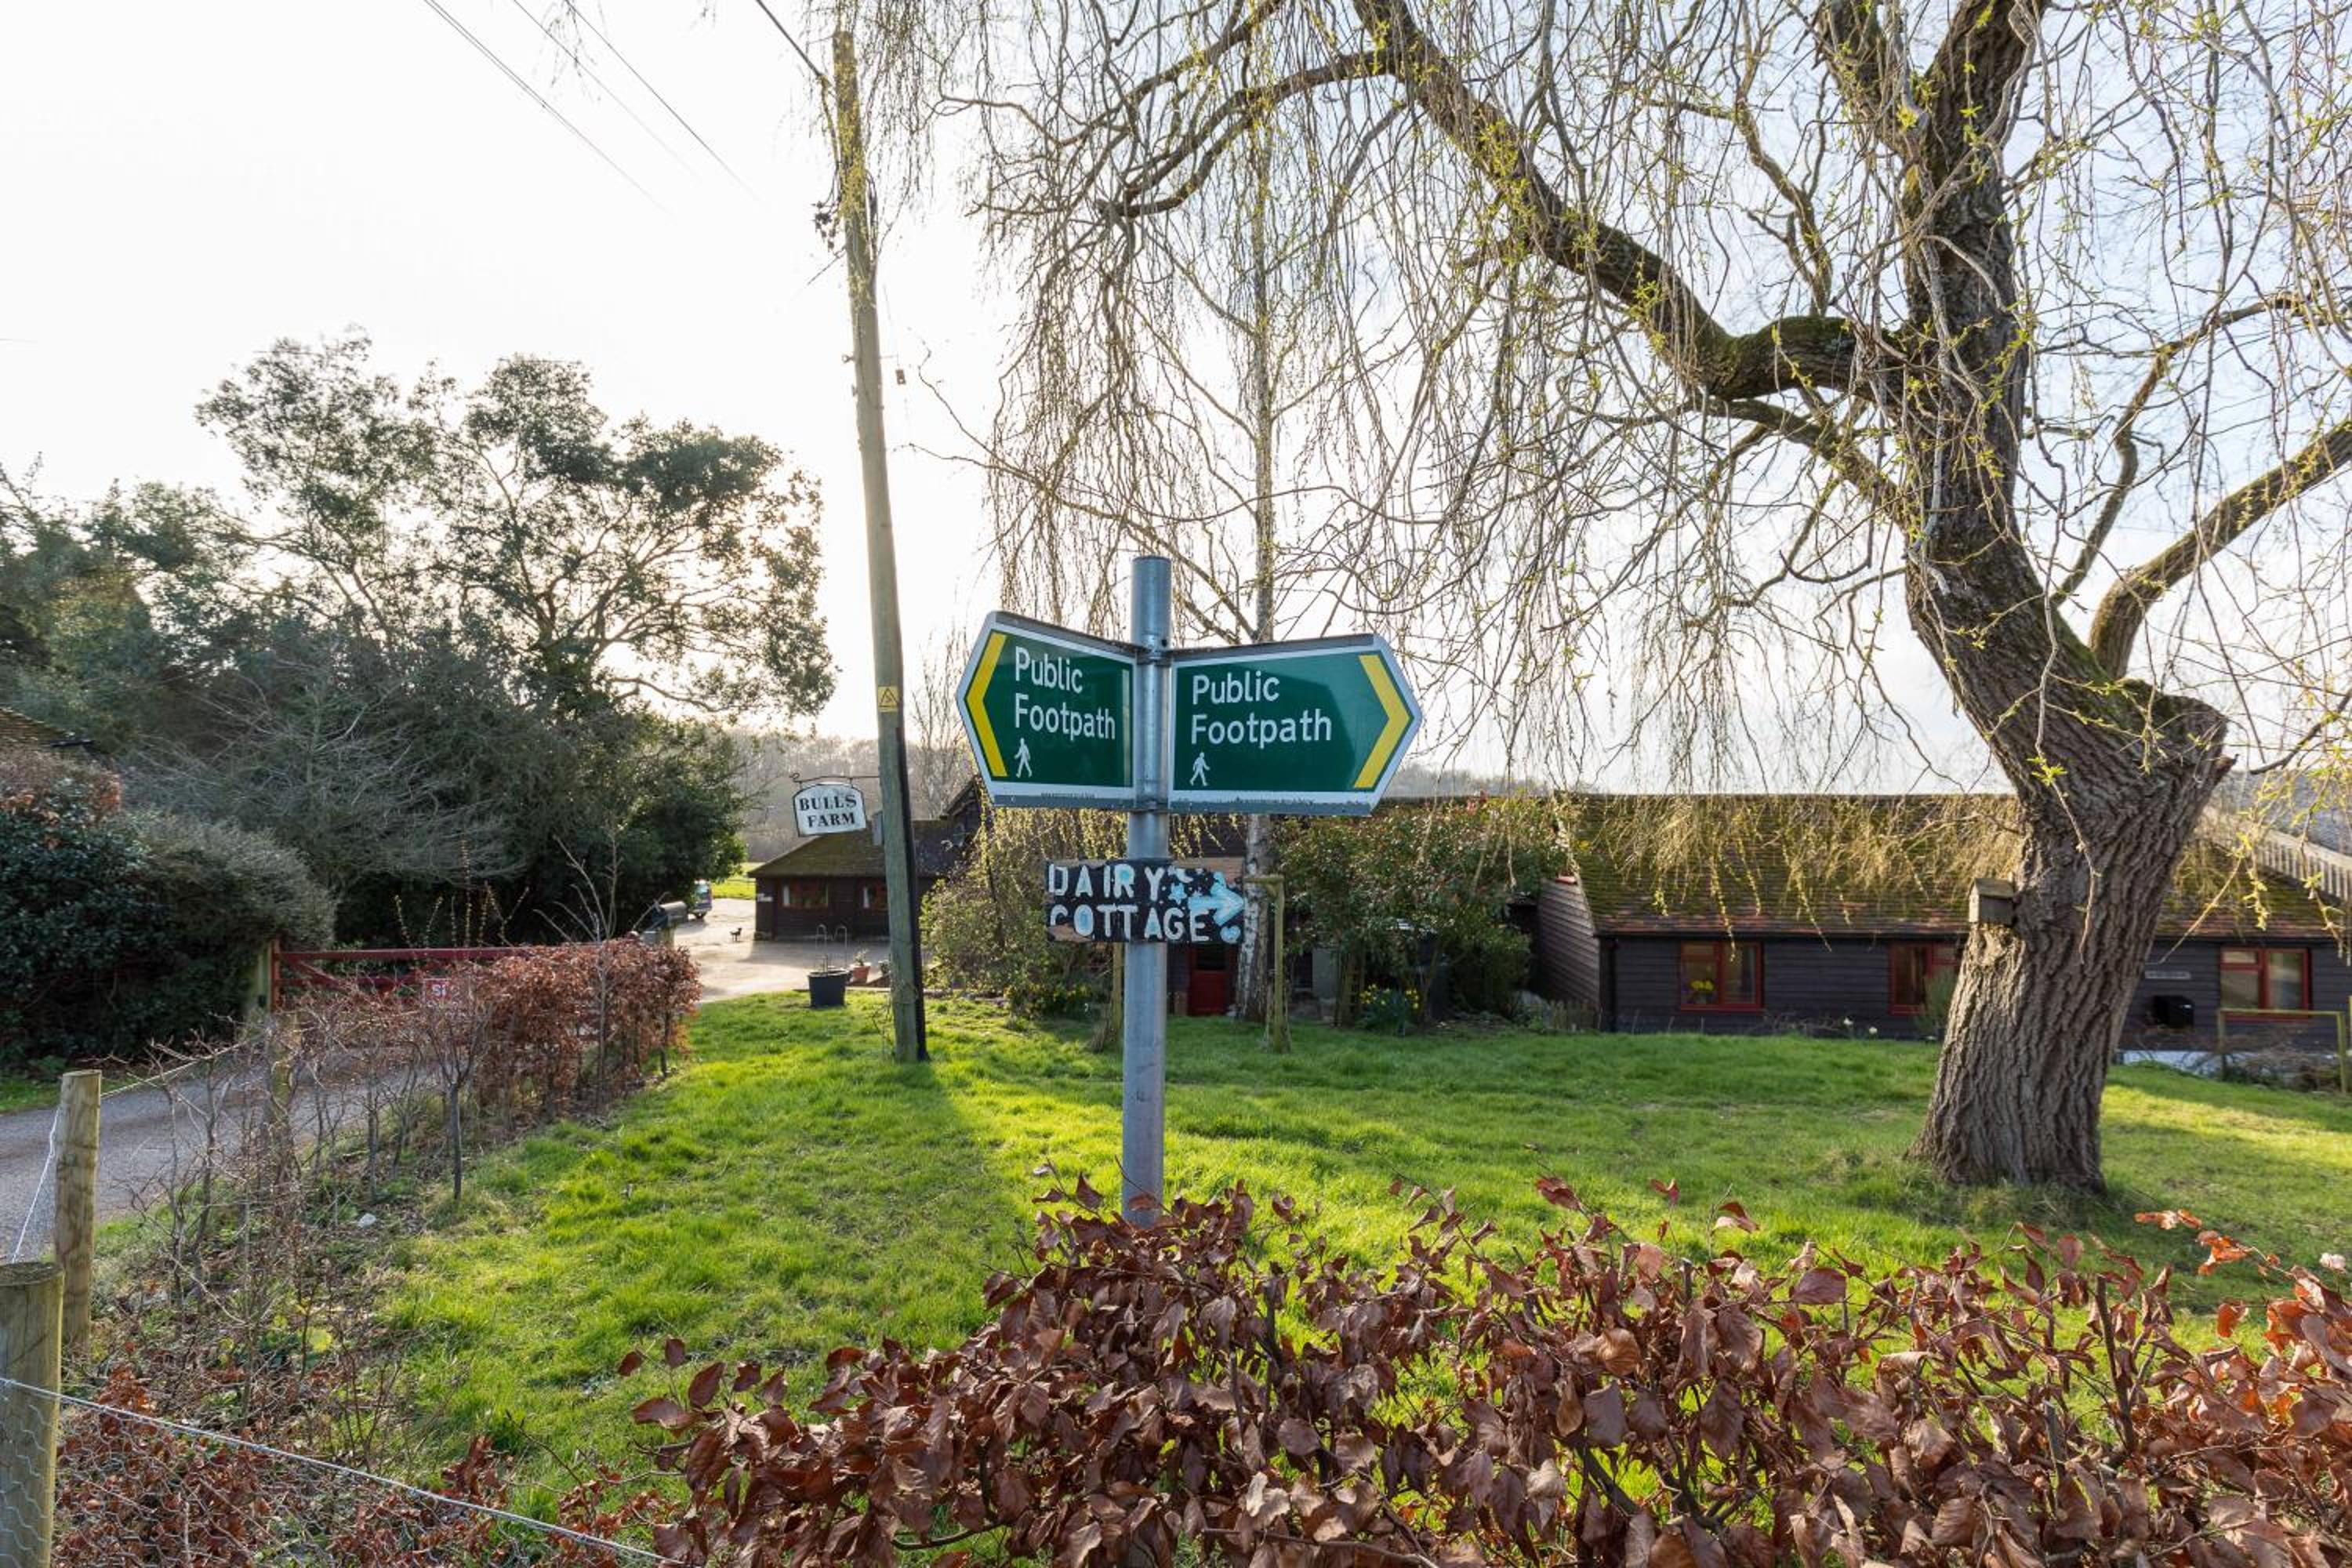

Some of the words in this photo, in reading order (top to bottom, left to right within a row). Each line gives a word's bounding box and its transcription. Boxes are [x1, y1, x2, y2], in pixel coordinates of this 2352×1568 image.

[1015, 646, 1083, 694] Public
[1192, 670, 1280, 705] Public
[1014, 692, 1116, 742] Footpath
[1191, 708, 1332, 750] Footpath
[807, 812, 855, 828] FARM
[1048, 863, 1165, 902] DAIRY
